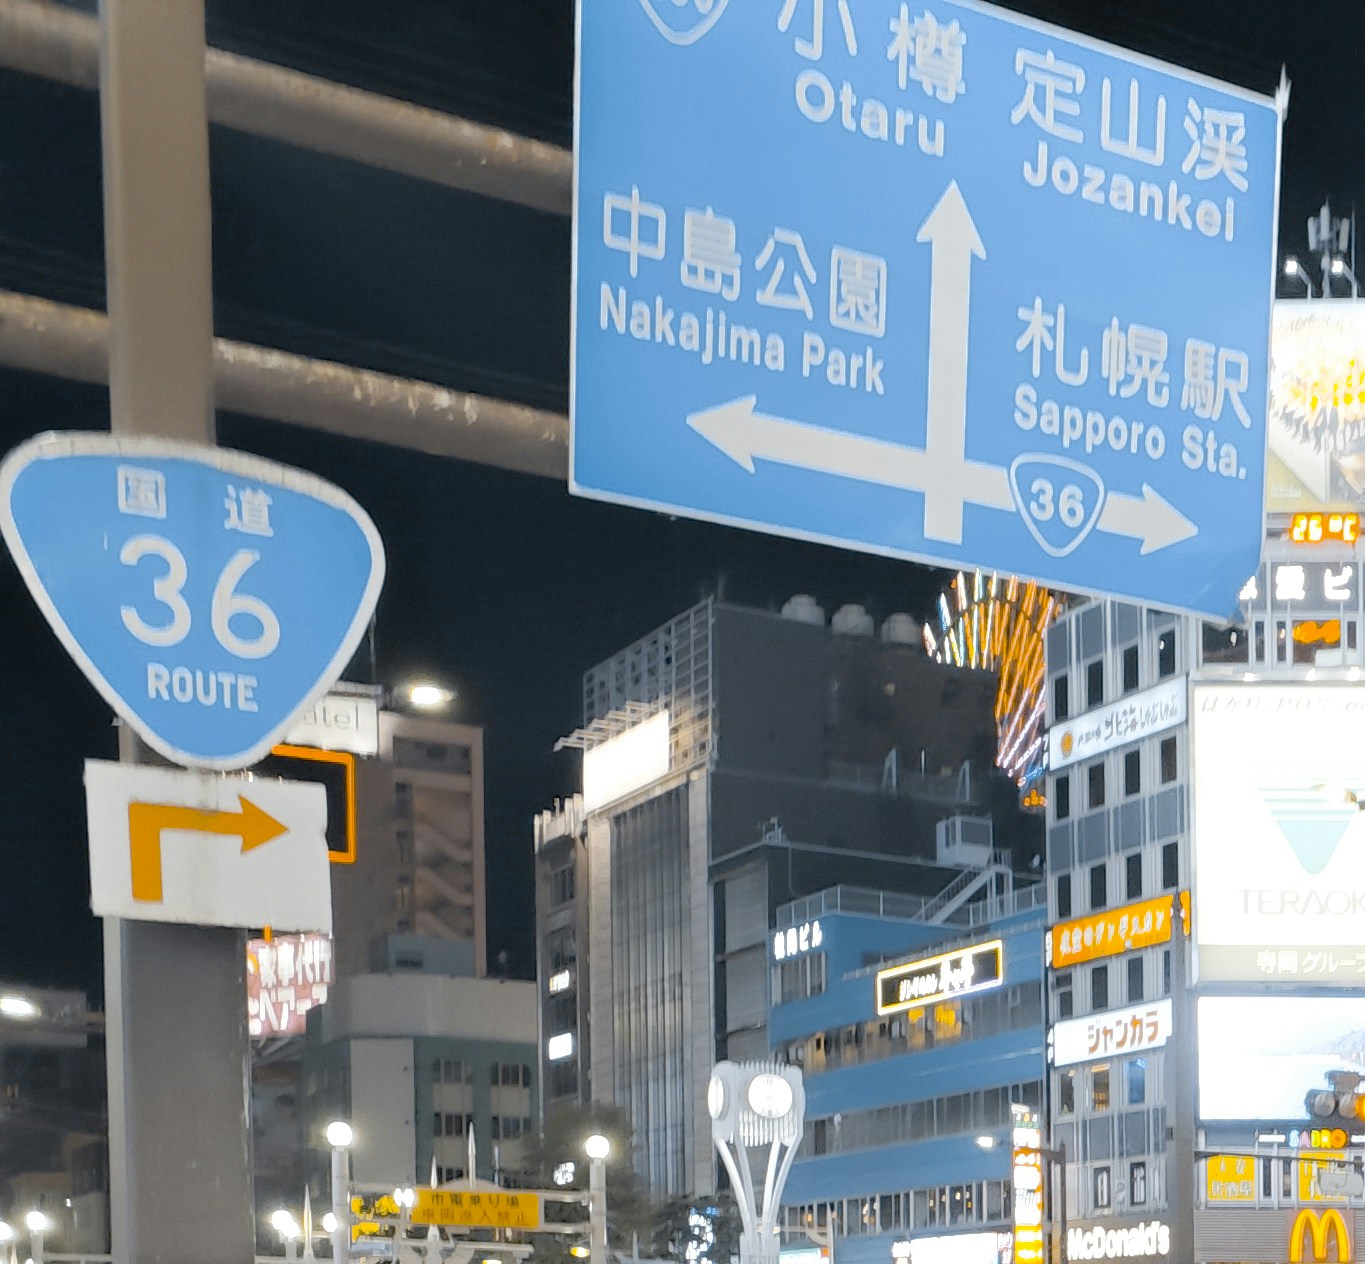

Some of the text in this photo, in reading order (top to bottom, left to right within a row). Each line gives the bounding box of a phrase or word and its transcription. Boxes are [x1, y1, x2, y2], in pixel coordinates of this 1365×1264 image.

[777, 0, 966, 104] 小樽
[795, 69, 945, 157] Otaru
[1011, 49, 1249, 192] 定山渓
[1022, 140, 1235, 242] Jozankei
[603, 185, 888, 338] 中島公園
[599, 283, 885, 395] Nakajima Park
[1015, 297, 1252, 428] 札幌駅
[1014, 383, 1248, 480] Sapporo Sta.
[117, 465, 274, 537] 国道
[1029, 478, 1085, 522] 36
[120, 534, 280, 659] 36
[148, 662, 258, 713] ROUTE
[1088, 1010, 1159, 1055] ジャンカラ
[1067, 1221, 1170, 1260] McDonald's
